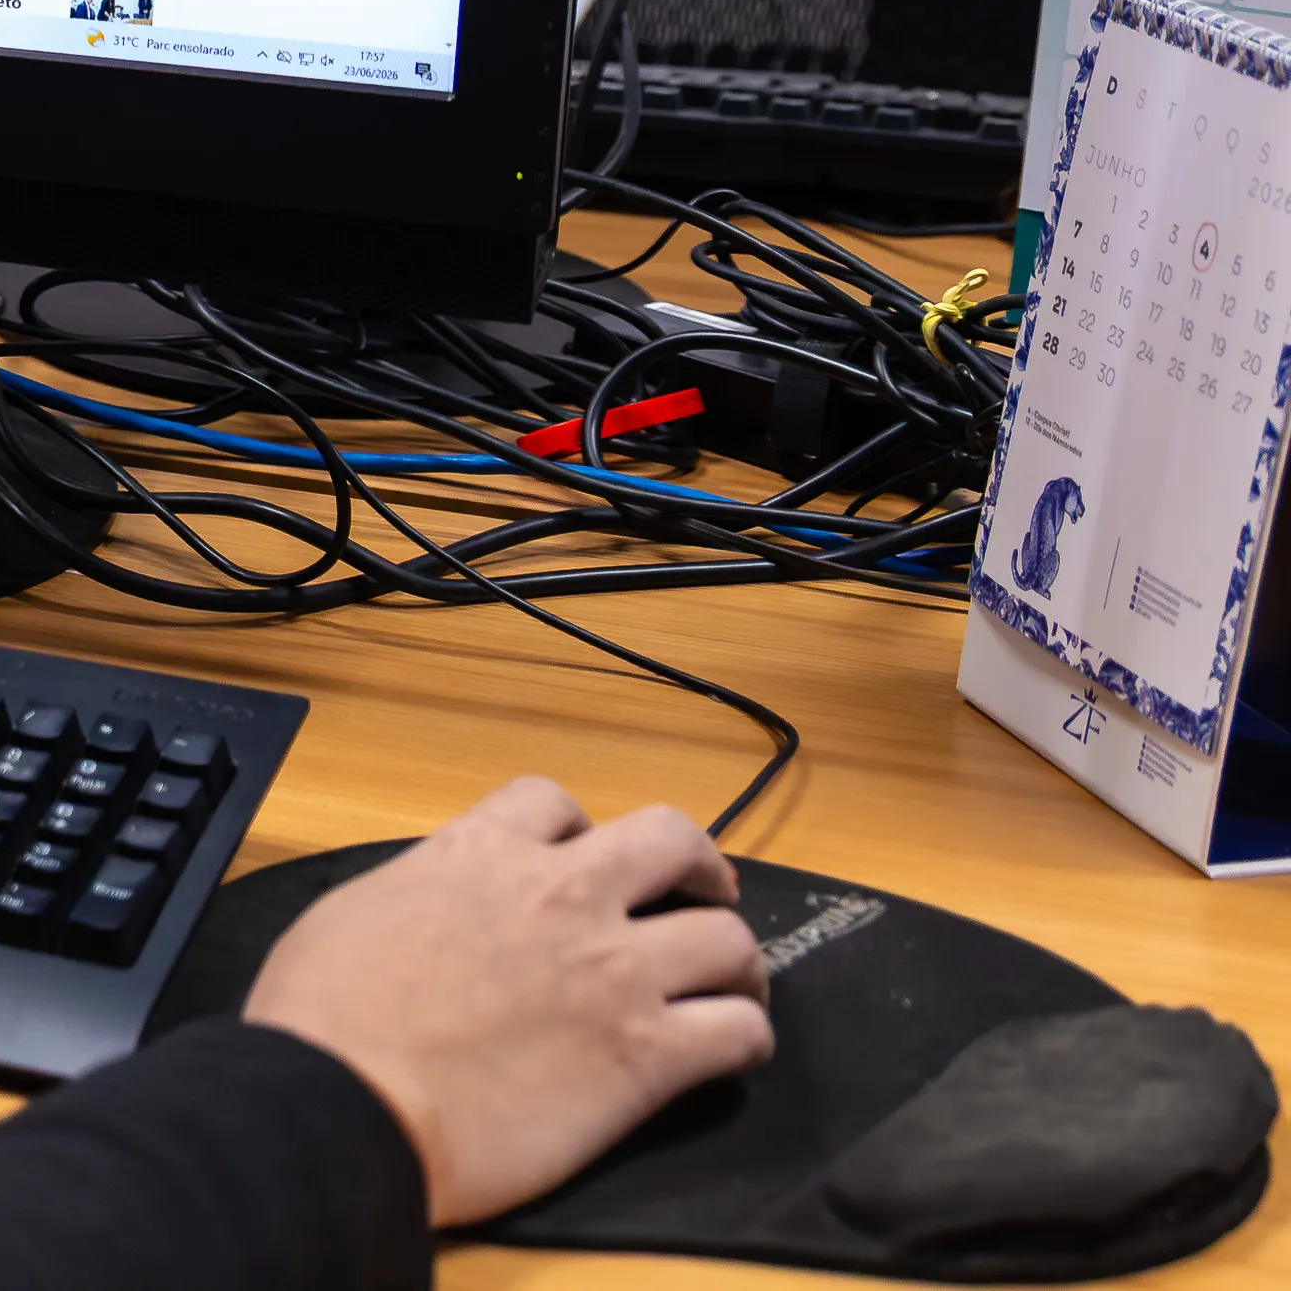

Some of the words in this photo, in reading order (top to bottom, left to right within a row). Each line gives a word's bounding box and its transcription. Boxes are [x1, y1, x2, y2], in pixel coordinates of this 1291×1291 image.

[113, 35, 140, 49] 31°C
[147, 39, 170, 53] Parc
[173, 42, 235, 59] ensolarado
[344, 66, 399, 81] 23/06/2026
[1106, 75, 1118, 96] D
[1135, 88, 1148, 110] S
[1168, 101, 1177, 121] T
[1194, 114, 1208, 142] Q
[1225, 128, 1240, 155] Q
[1258, 142, 1271, 165] S
[1085, 144, 1147, 188] JUNHO
[1074, 220, 1083, 239] 7
[1099, 234, 1110, 254] 8
[1129, 248, 1140, 268] 9
[1157, 261, 1173, 286] 10
[1189, 277, 1203, 301] 11
[1220, 292, 1237, 318] 12
[1253, 308, 1270, 335] 13
[1111, 194, 1118, 214] 1
[1137, 209, 1149, 230] 2
[1168, 223, 1180, 244] 3
[1200, 240, 1210, 260] 4
[1231, 253, 1243, 276] 5
[1264, 270, 1277, 293] 6
[1042, 331, 1060, 356] 28
[1068, 346, 1087, 370] 29
[1096, 362, 1116, 388] 30
[1052, 294, 1068, 317] 21
[1077, 309, 1096, 333] 22
[1106, 324, 1125, 349] 23
[1135, 340, 1155, 365] 24
[1167, 356, 1186, 382] 25
[1197, 372, 1218, 399] 26
[1231, 390, 1253, 415] 27
[1061, 256, 1076, 280] 14
[1089, 270, 1103, 294] 15
[1118, 286, 1133, 310] 16
[1149, 301, 1165, 324] 17
[1179, 316, 1195, 342] 18
[1211, 331, 1227, 358] 19
[1240, 349, 1263, 376] 20
